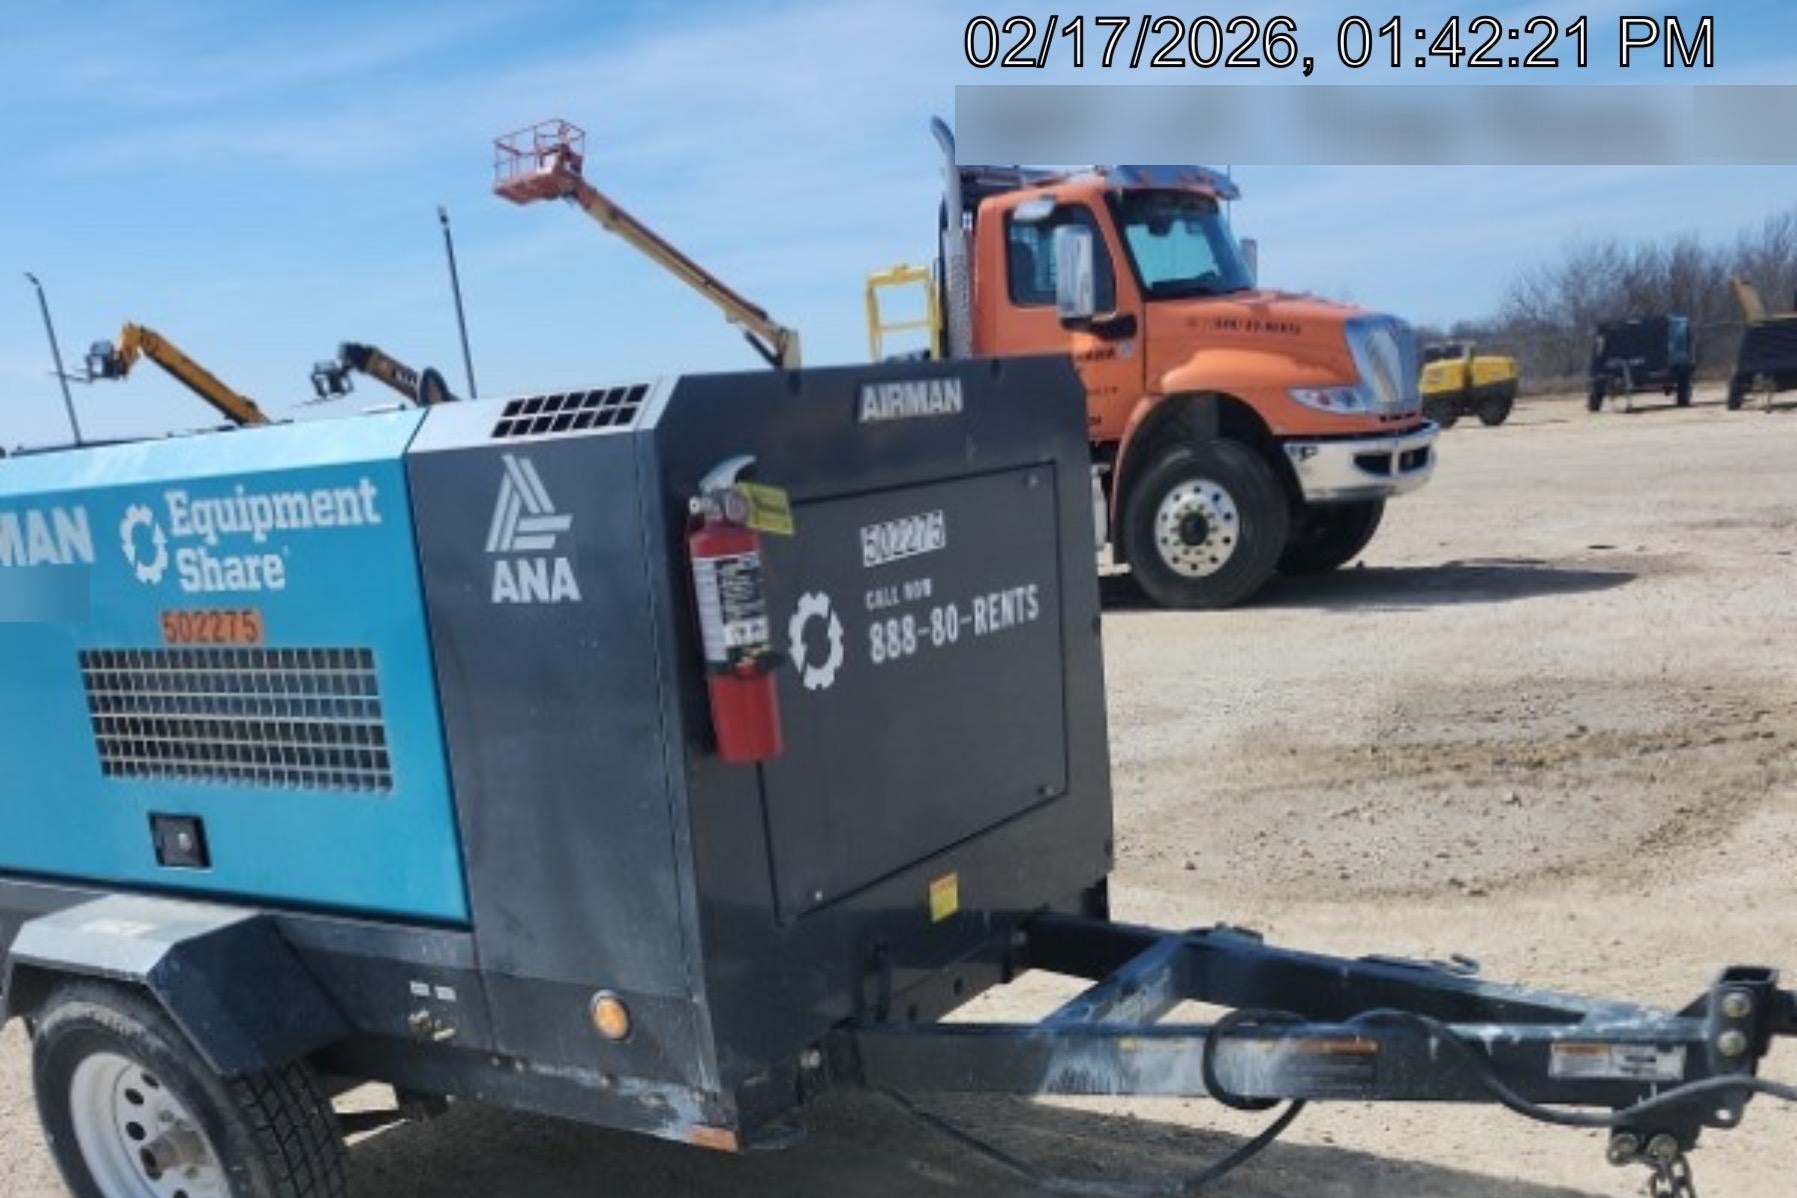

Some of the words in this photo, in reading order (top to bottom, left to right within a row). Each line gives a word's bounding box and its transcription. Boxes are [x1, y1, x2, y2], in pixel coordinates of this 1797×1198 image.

[860, 376, 963, 423] AIRMAN
[165, 478, 381, 545] Equipment
[176, 545, 286, 592] Share
[491, 557, 582, 604] ANA
[866, 585, 899, 611] CALL
[903, 577, 932, 601] NOW
[162, 609, 257, 643] 502275
[869, 583, 1039, 664] 888-80-RENTS
